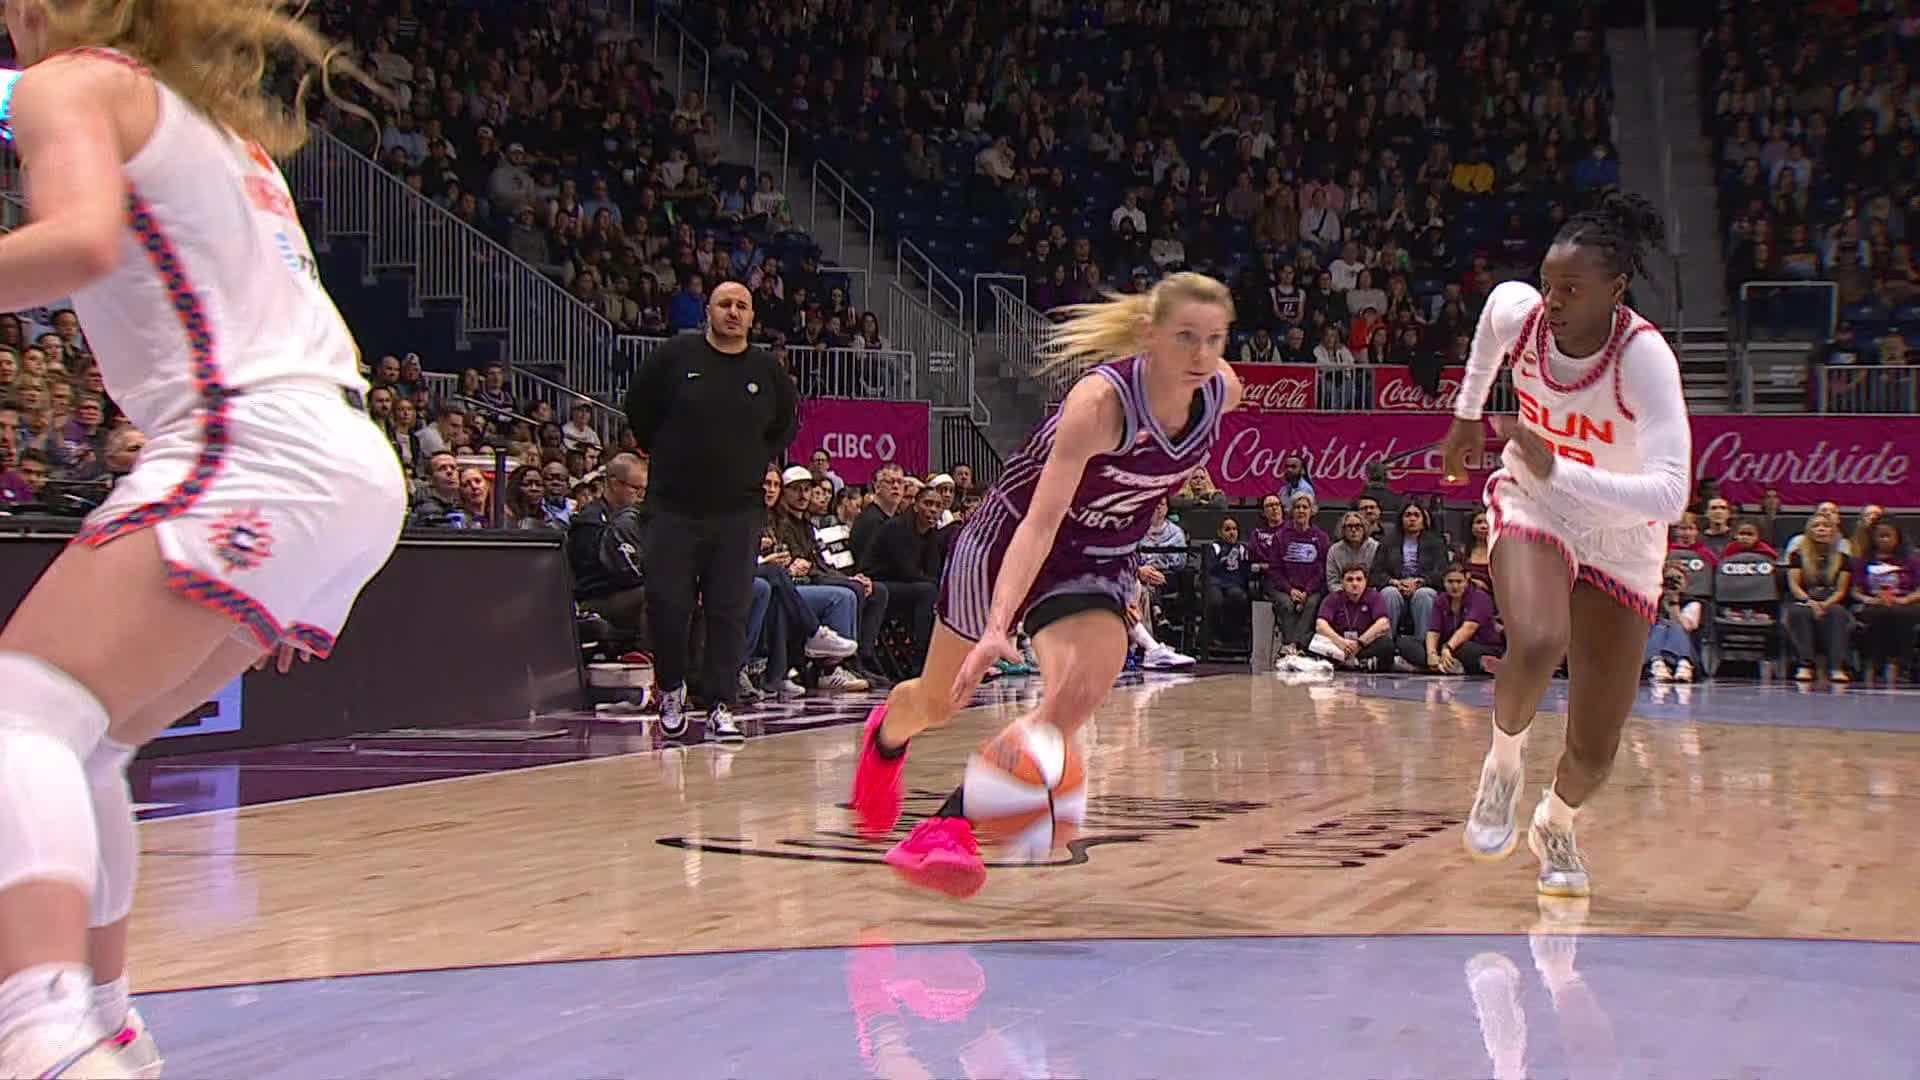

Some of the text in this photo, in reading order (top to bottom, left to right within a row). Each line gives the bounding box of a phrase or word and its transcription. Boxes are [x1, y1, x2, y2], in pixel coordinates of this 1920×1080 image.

[1237, 376, 1313, 408] ca-Cola
[1516, 388, 1614, 443] SUN
[822, 432, 873, 459] CIBC
[1221, 427, 1409, 482] Courtside
[1696, 431, 1911, 485] Courtside
